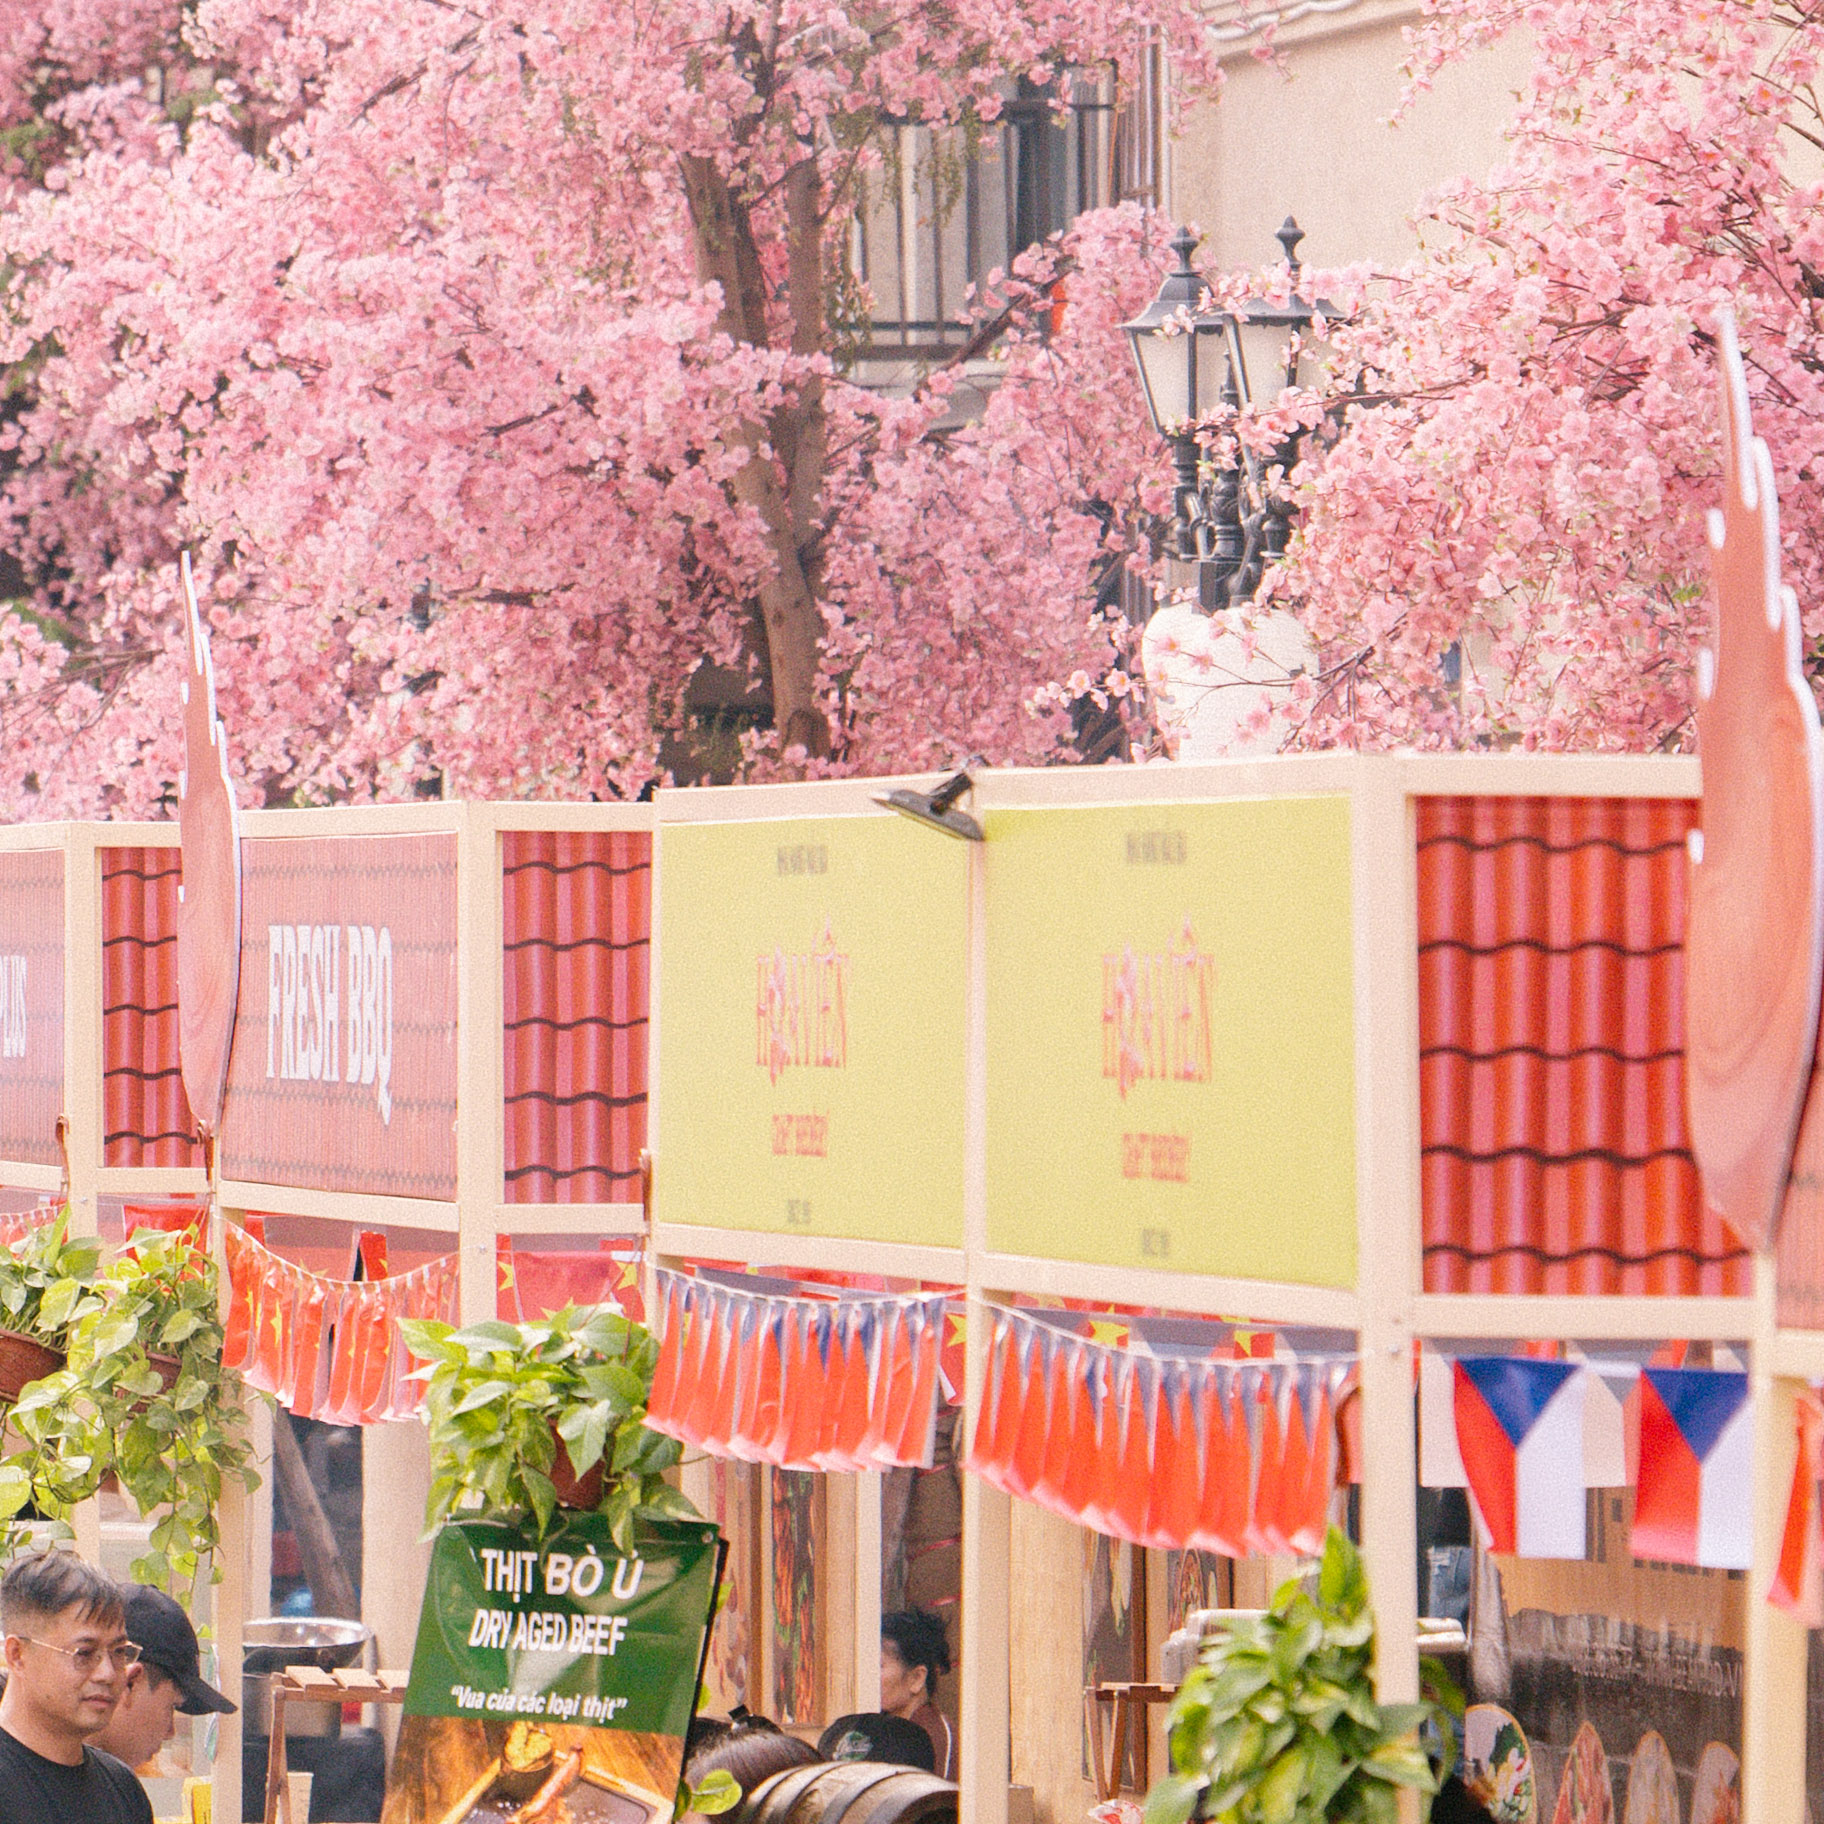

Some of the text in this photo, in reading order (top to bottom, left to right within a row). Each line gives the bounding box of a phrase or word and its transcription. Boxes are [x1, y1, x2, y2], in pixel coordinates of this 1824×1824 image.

[266, 924, 393, 1125] FRESH BBQ
[481, 1548, 538, 1603] THỊT
[545, 1544, 604, 1597] BÒ
[468, 1608, 628, 1656] DRY AGED BEEF
[486, 1687, 515, 1712] của
[516, 1690, 545, 1714] các
[547, 1692, 580, 1721] loại
